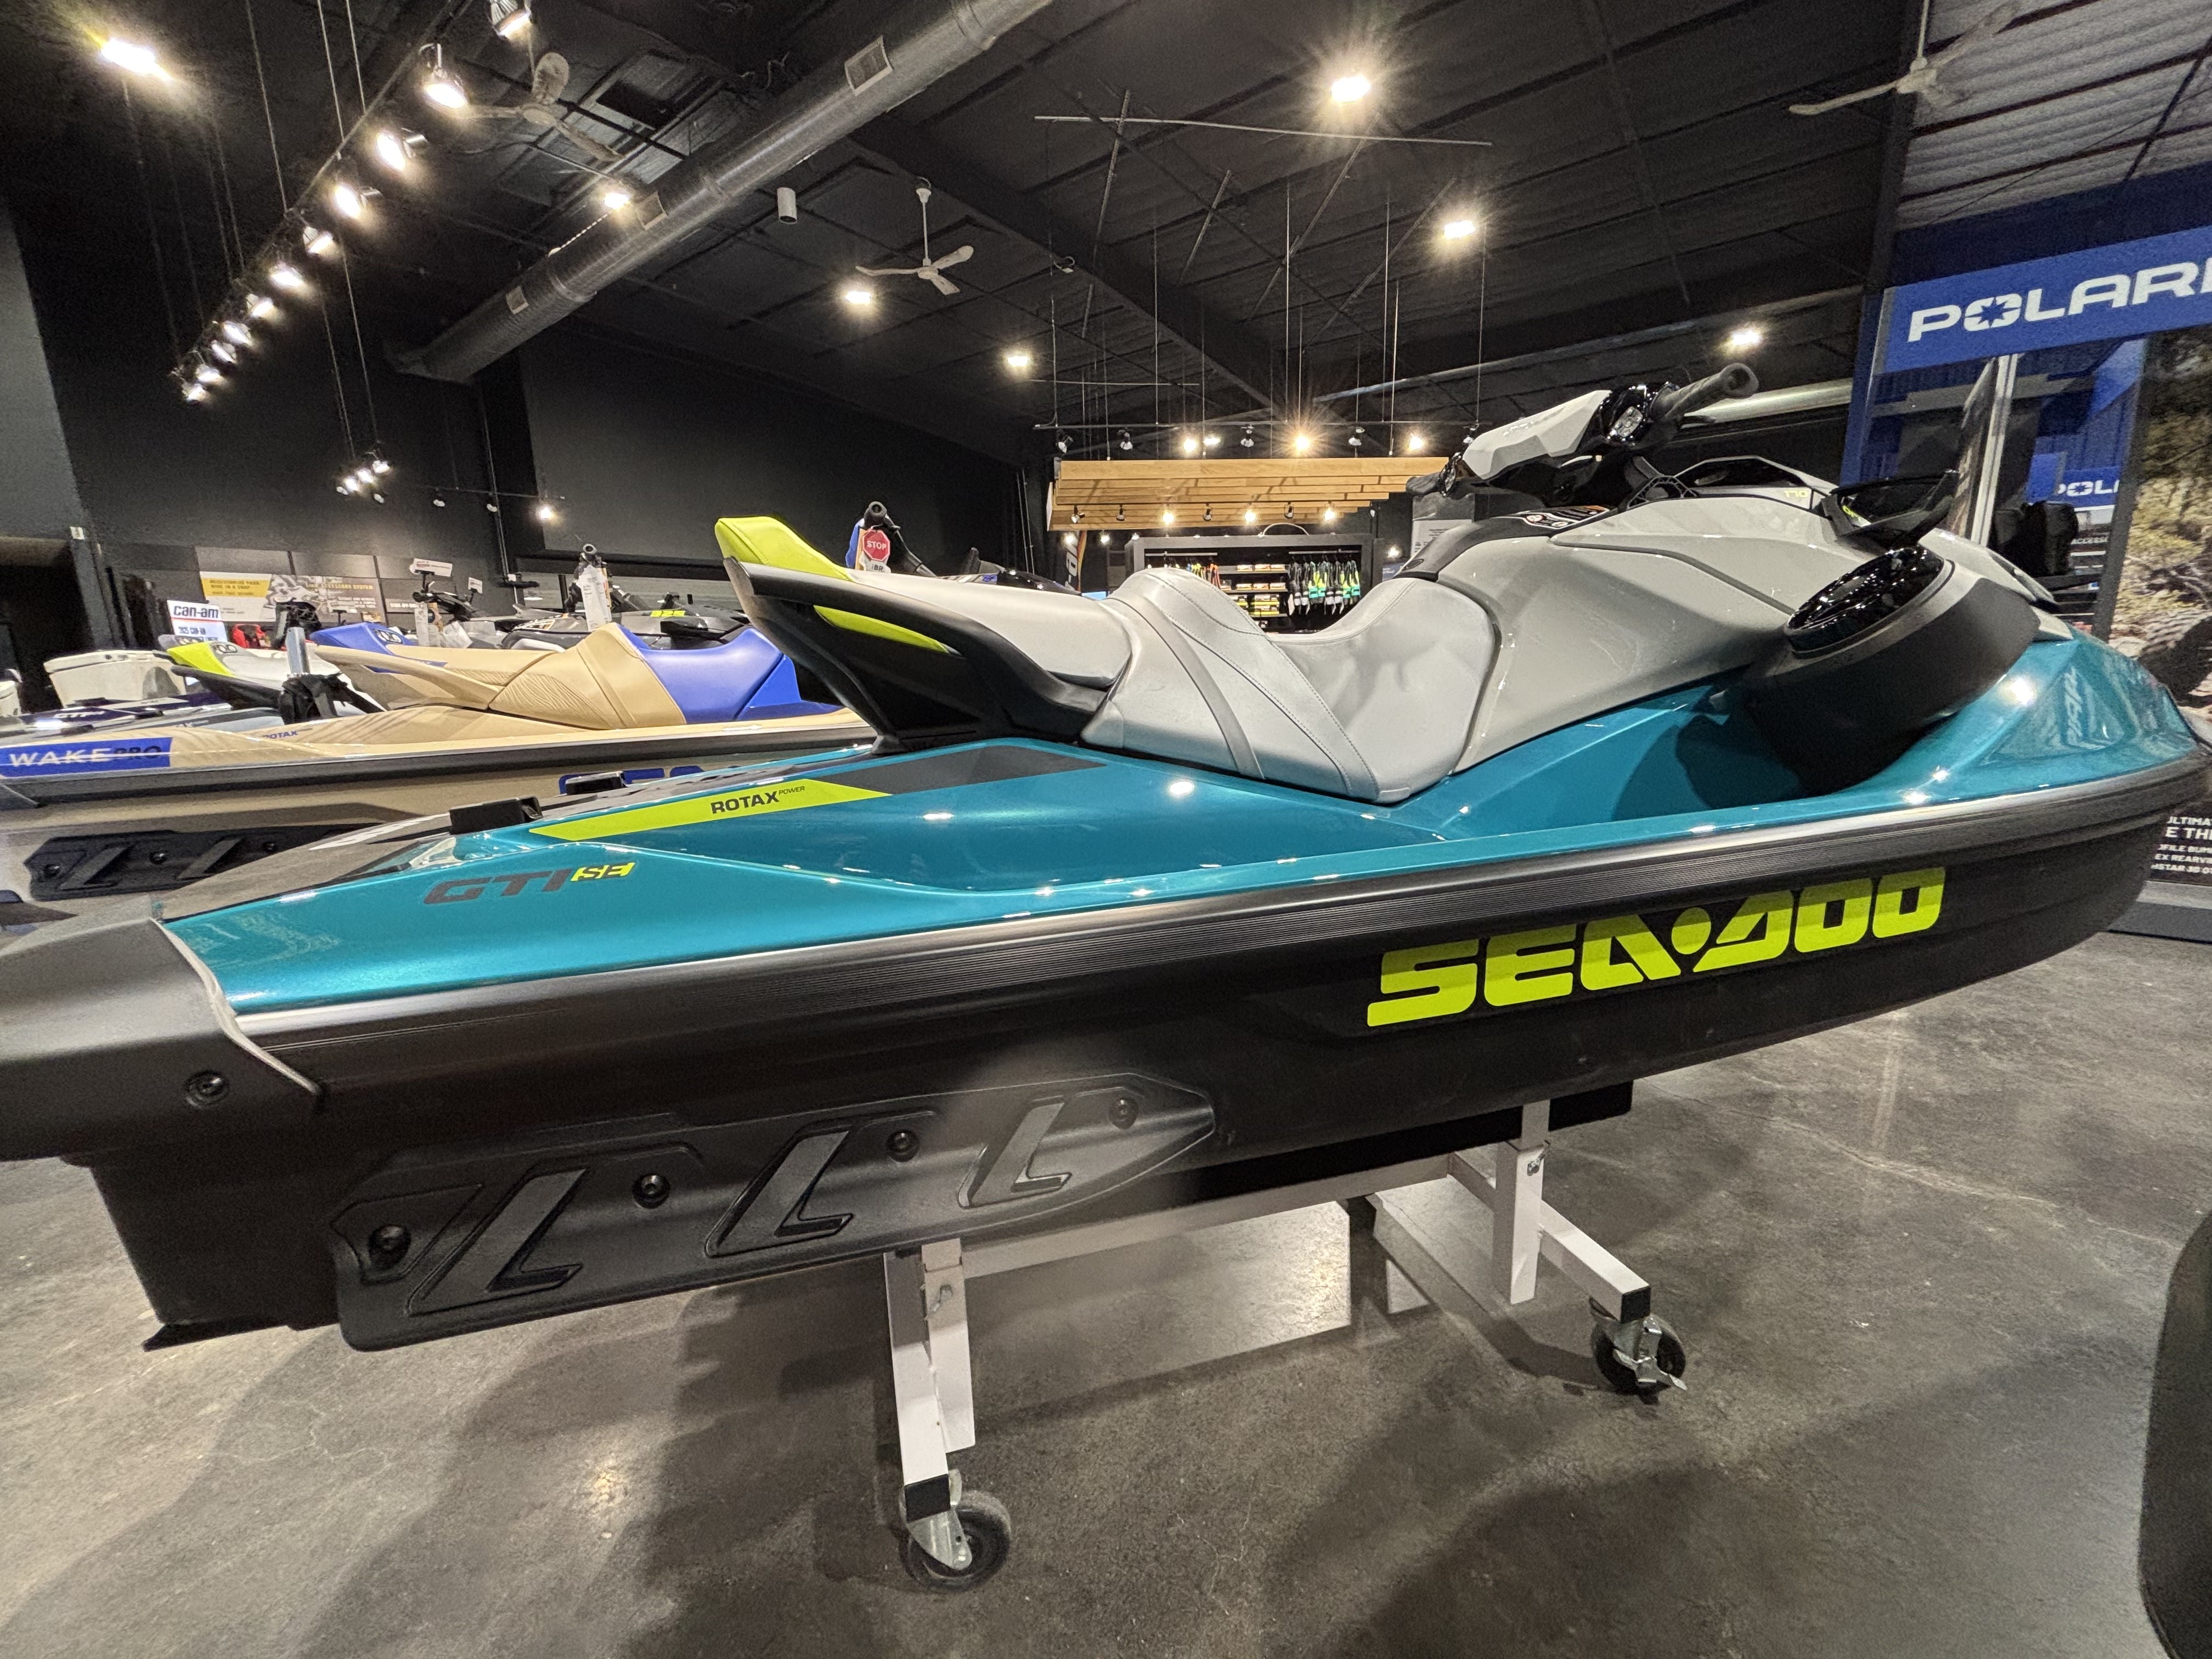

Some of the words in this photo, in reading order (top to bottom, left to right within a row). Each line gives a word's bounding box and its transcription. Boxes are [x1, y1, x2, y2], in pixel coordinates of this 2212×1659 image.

[1784, 490, 1808, 498] 170
[867, 540, 887, 550] STOP
[173, 606, 219, 618] can-am
[9, 748, 111, 768] WAKE
[711, 791, 780, 814] ROTAX
[778, 786, 805, 795] POWER
[423, 870, 572, 905] GTI
[576, 864, 631, 881] SE
